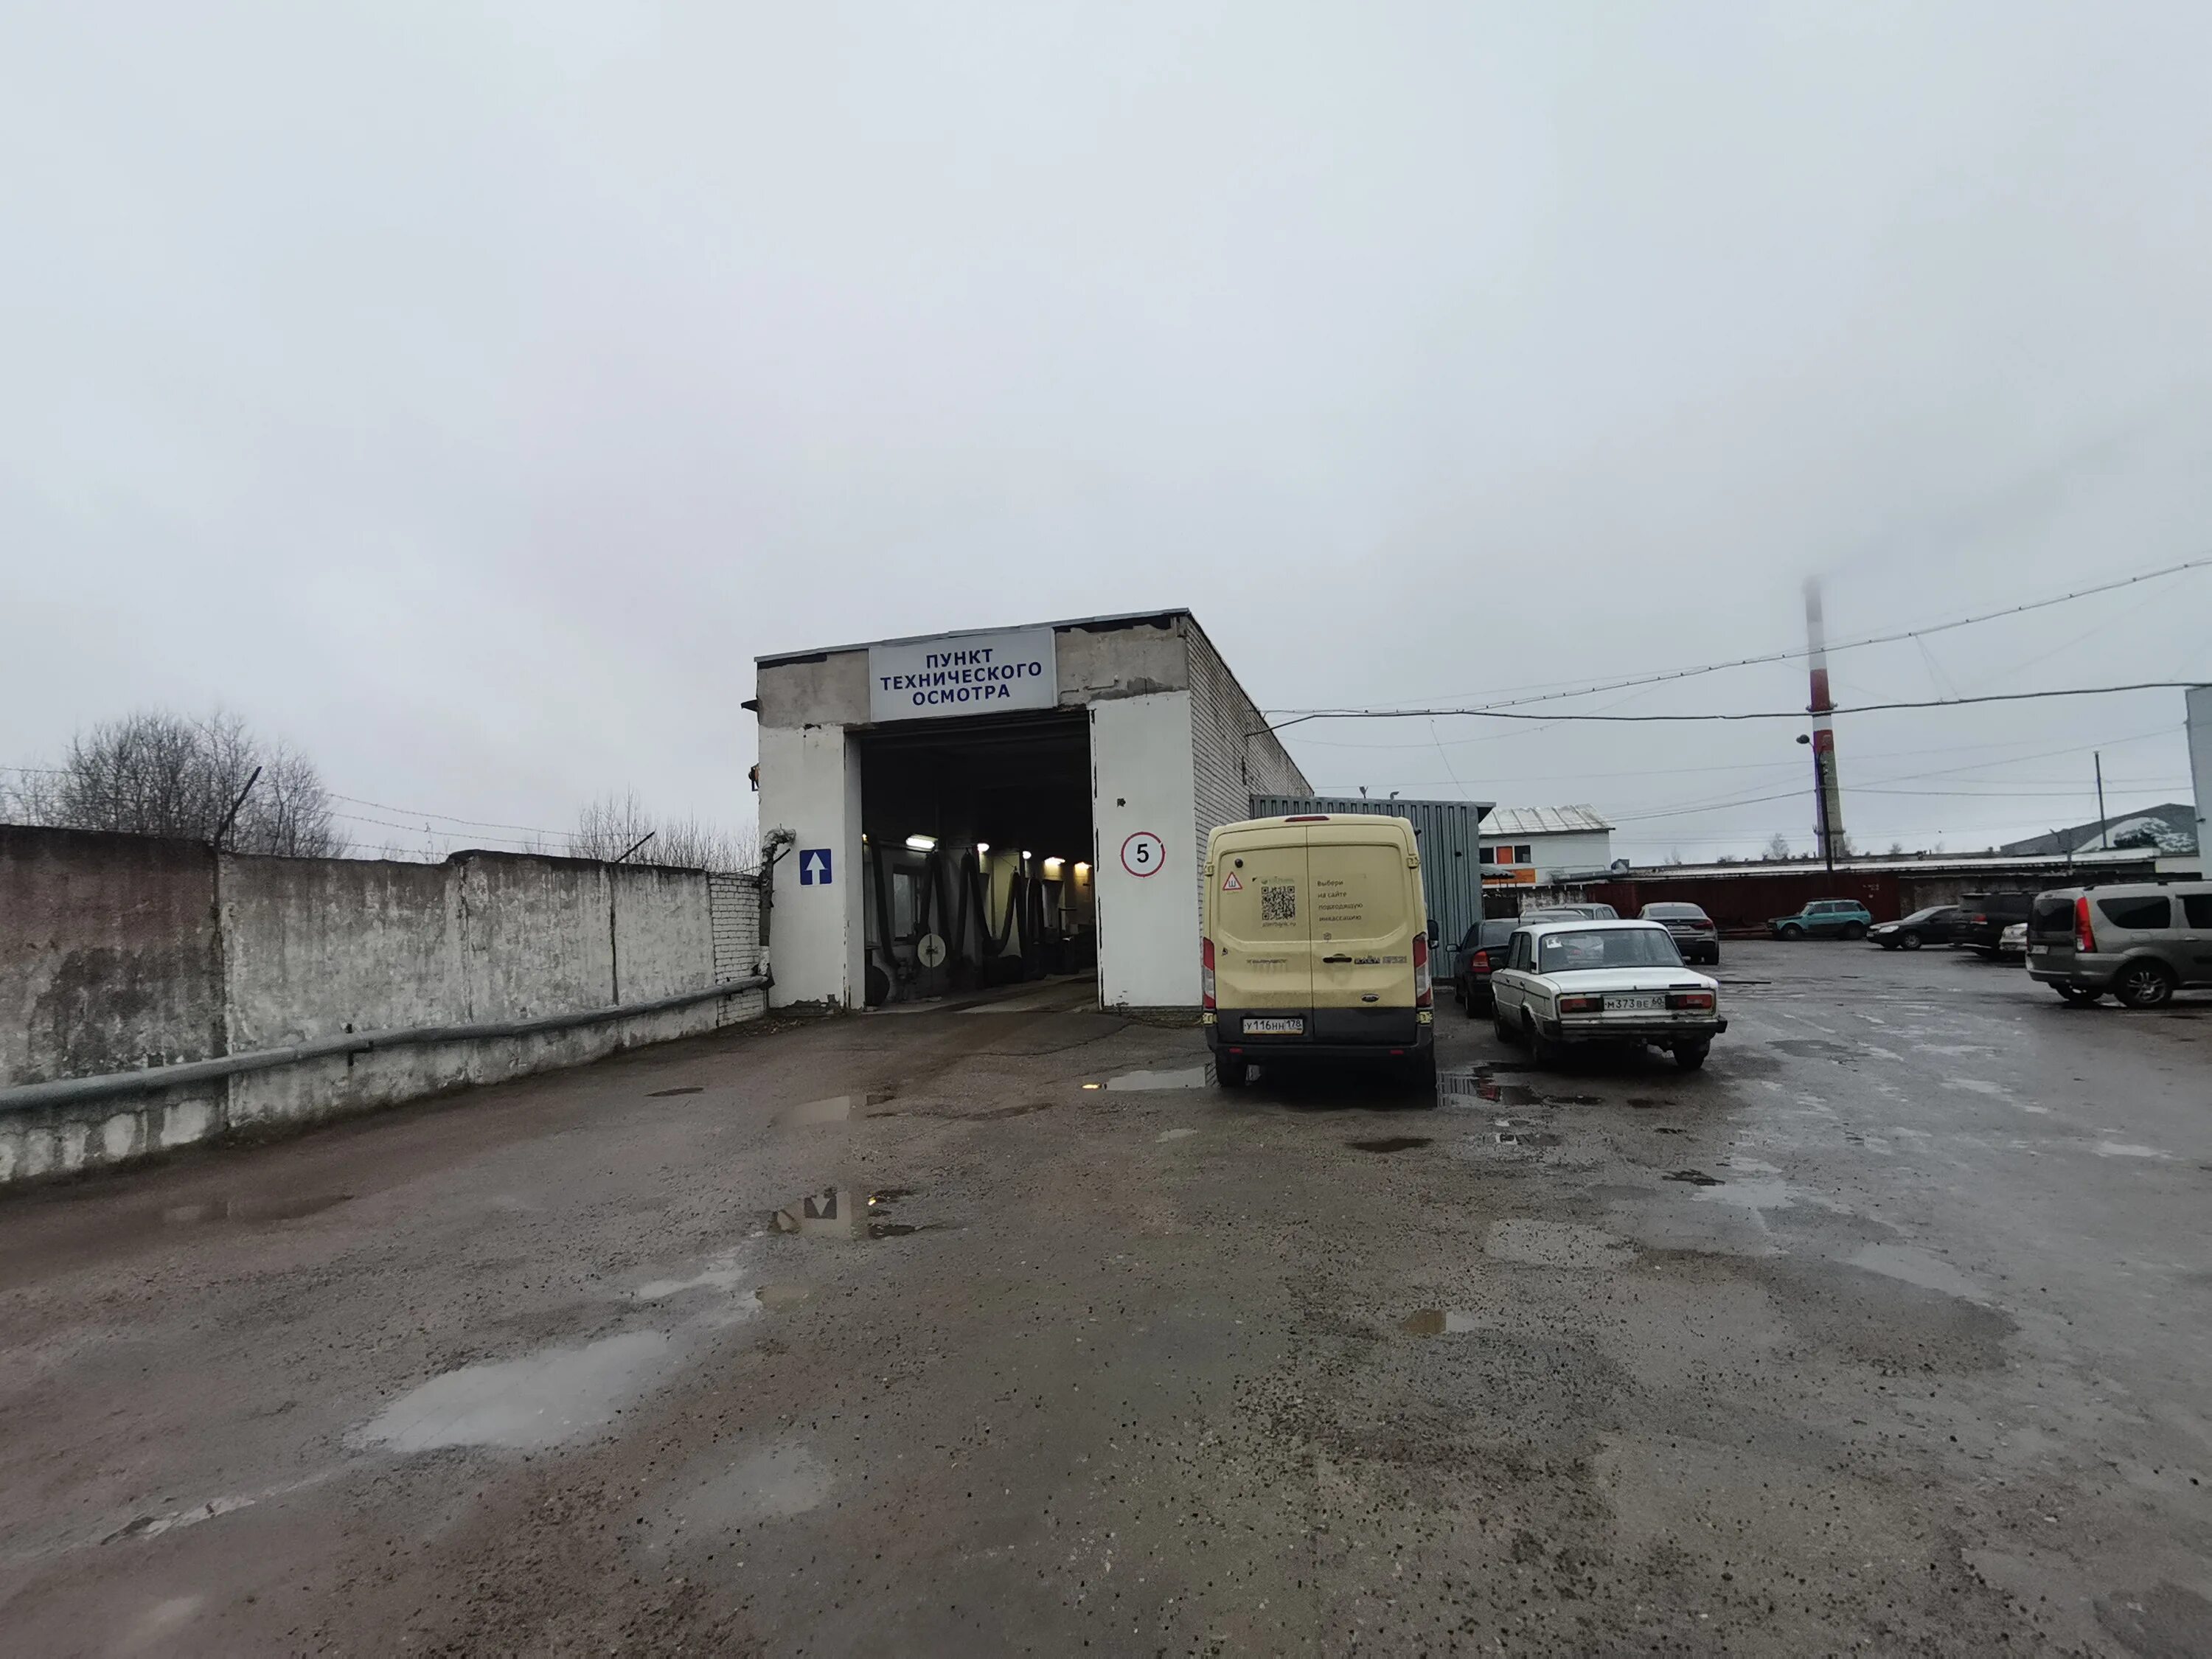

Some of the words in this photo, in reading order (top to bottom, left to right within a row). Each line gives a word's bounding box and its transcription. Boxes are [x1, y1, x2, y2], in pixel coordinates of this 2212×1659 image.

[926, 649, 992, 668] ПУНКТ
[880, 662, 1042, 690] ТЕХНИЧЕСКОГО
[913, 684, 1010, 706] ОСМОТРА
[1137, 844, 1149, 863] 5
